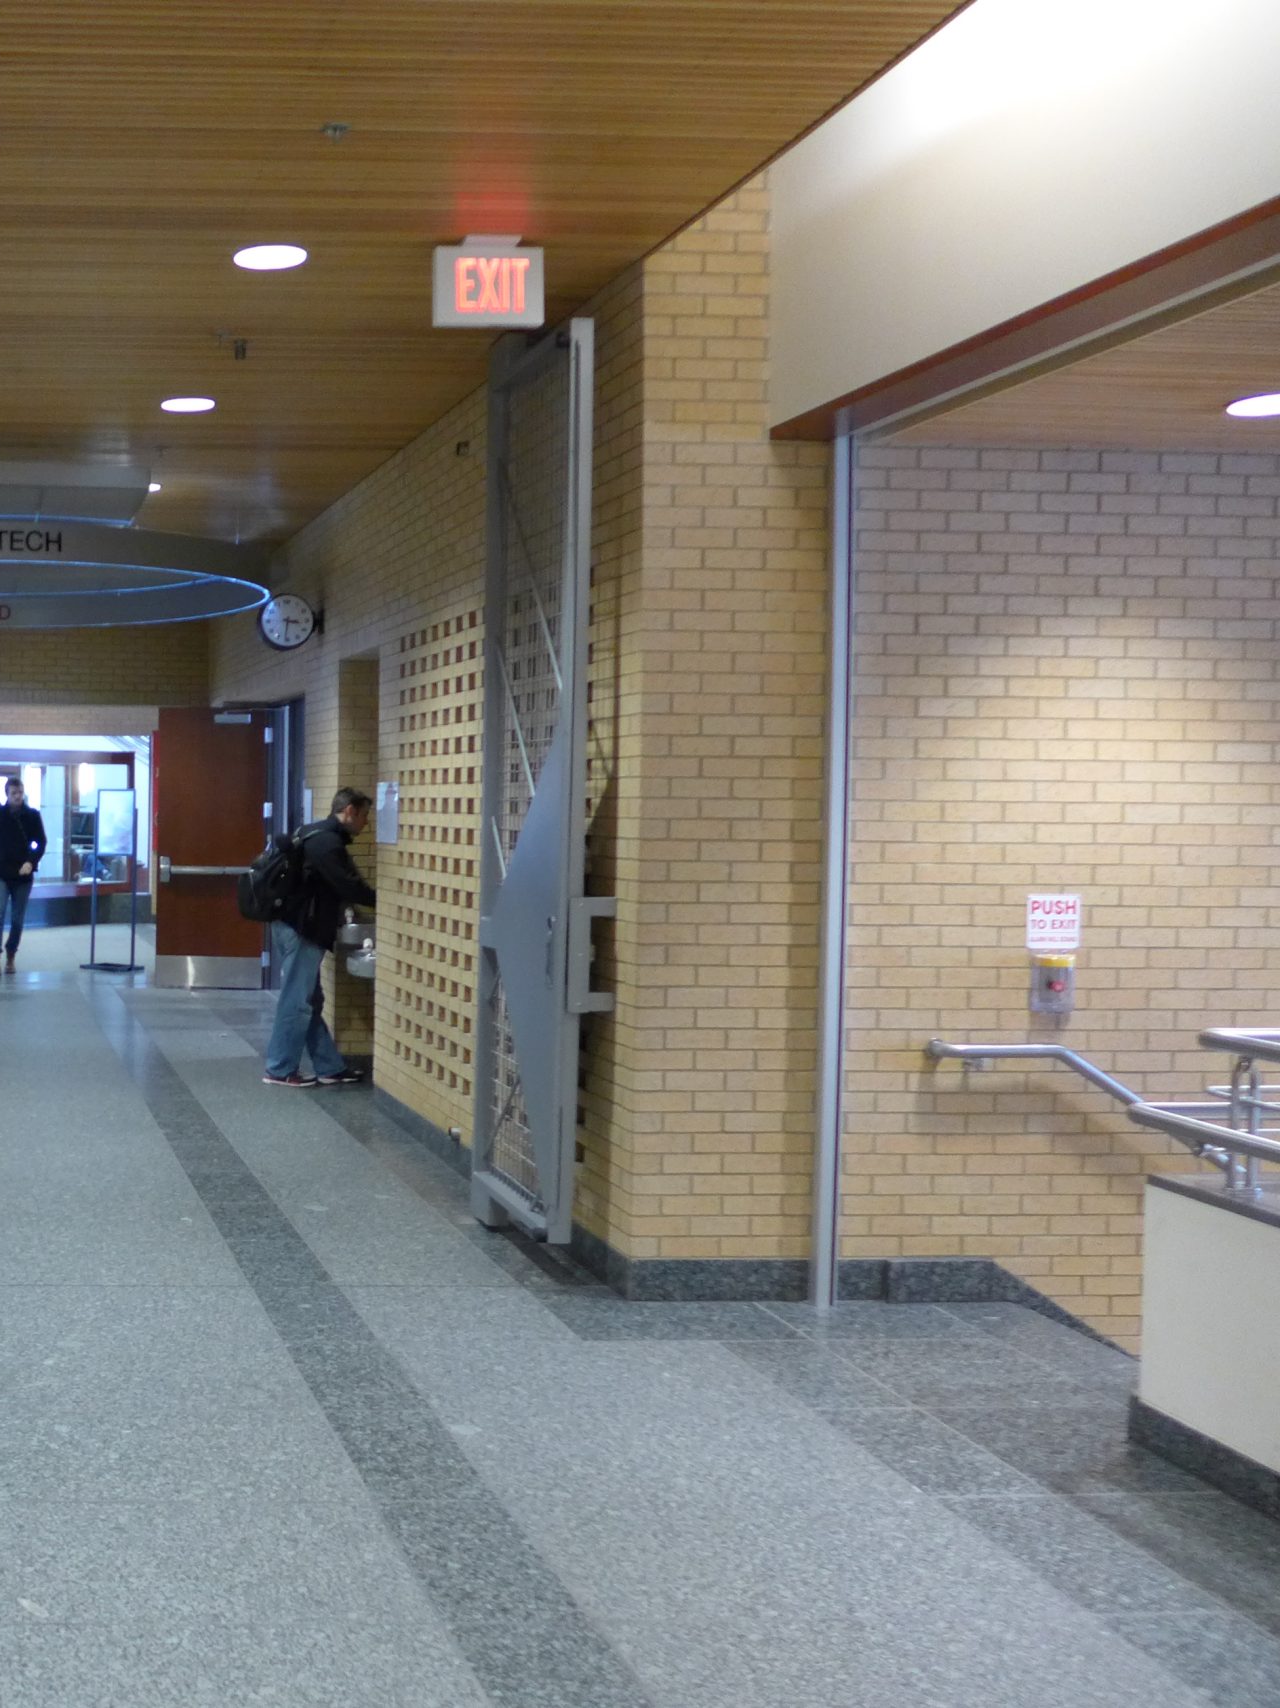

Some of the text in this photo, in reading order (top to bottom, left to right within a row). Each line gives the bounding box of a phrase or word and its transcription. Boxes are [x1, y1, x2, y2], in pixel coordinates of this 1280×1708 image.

[455, 257, 530, 314] EXIT
[1031, 900, 1076, 915] PUSH
[1031, 919, 1076, 930] TO EXIT
